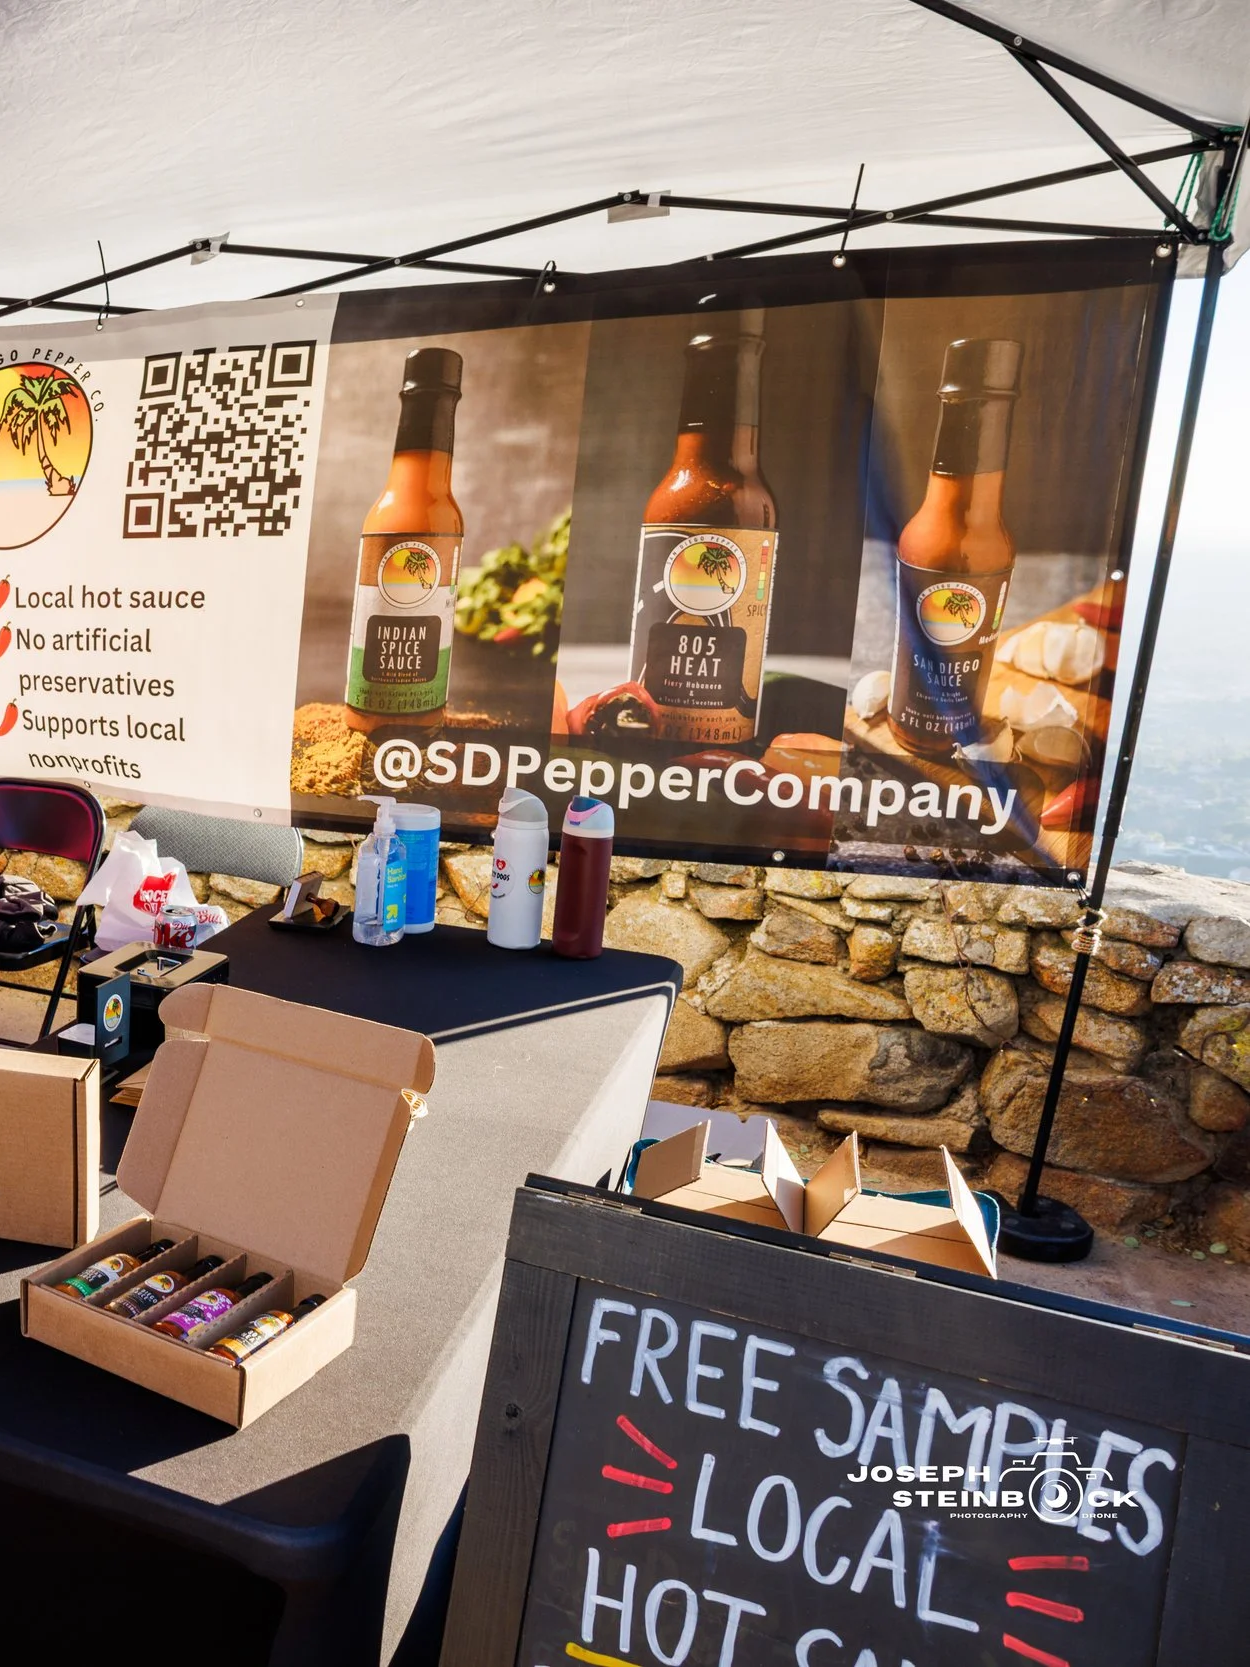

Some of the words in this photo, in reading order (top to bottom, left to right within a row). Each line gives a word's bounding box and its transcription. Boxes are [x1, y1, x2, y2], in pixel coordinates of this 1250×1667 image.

[32, 348, 91, 383] PEPPER
[679, 536, 705, 549] DIEGO
[15, 584, 74, 610] Local
[81, 585, 123, 609] hot
[129, 588, 206, 610] sauce
[16, 628, 46, 651] No
[52, 628, 151, 654] artificial
[377, 626, 426, 641] INDIAN
[678, 635, 717, 656] 805
[381, 641, 420, 655] SPICE
[380, 655, 422, 670] SAUCE
[670, 656, 721, 677] HEAT
[913, 654, 933, 672] SAN
[939, 659, 980, 674] DIEGO
[19, 671, 175, 698] preservatives
[927, 672, 962, 687] SAUCE
[22, 709, 120, 739] Supports
[127, 714, 186, 742] local
[901, 713, 906, 722] 5
[926, 722, 940, 732] OZ
[28, 751, 141, 780] nonprofits
[373, 738, 1018, 835] @SDPepperCompany
[579, 1297, 796, 1438] FREE
[813, 1356, 1178, 1558] SAMPLES
[689, 1452, 979, 1635] LOCAL
[581, 1547, 768, 1667] HOT
